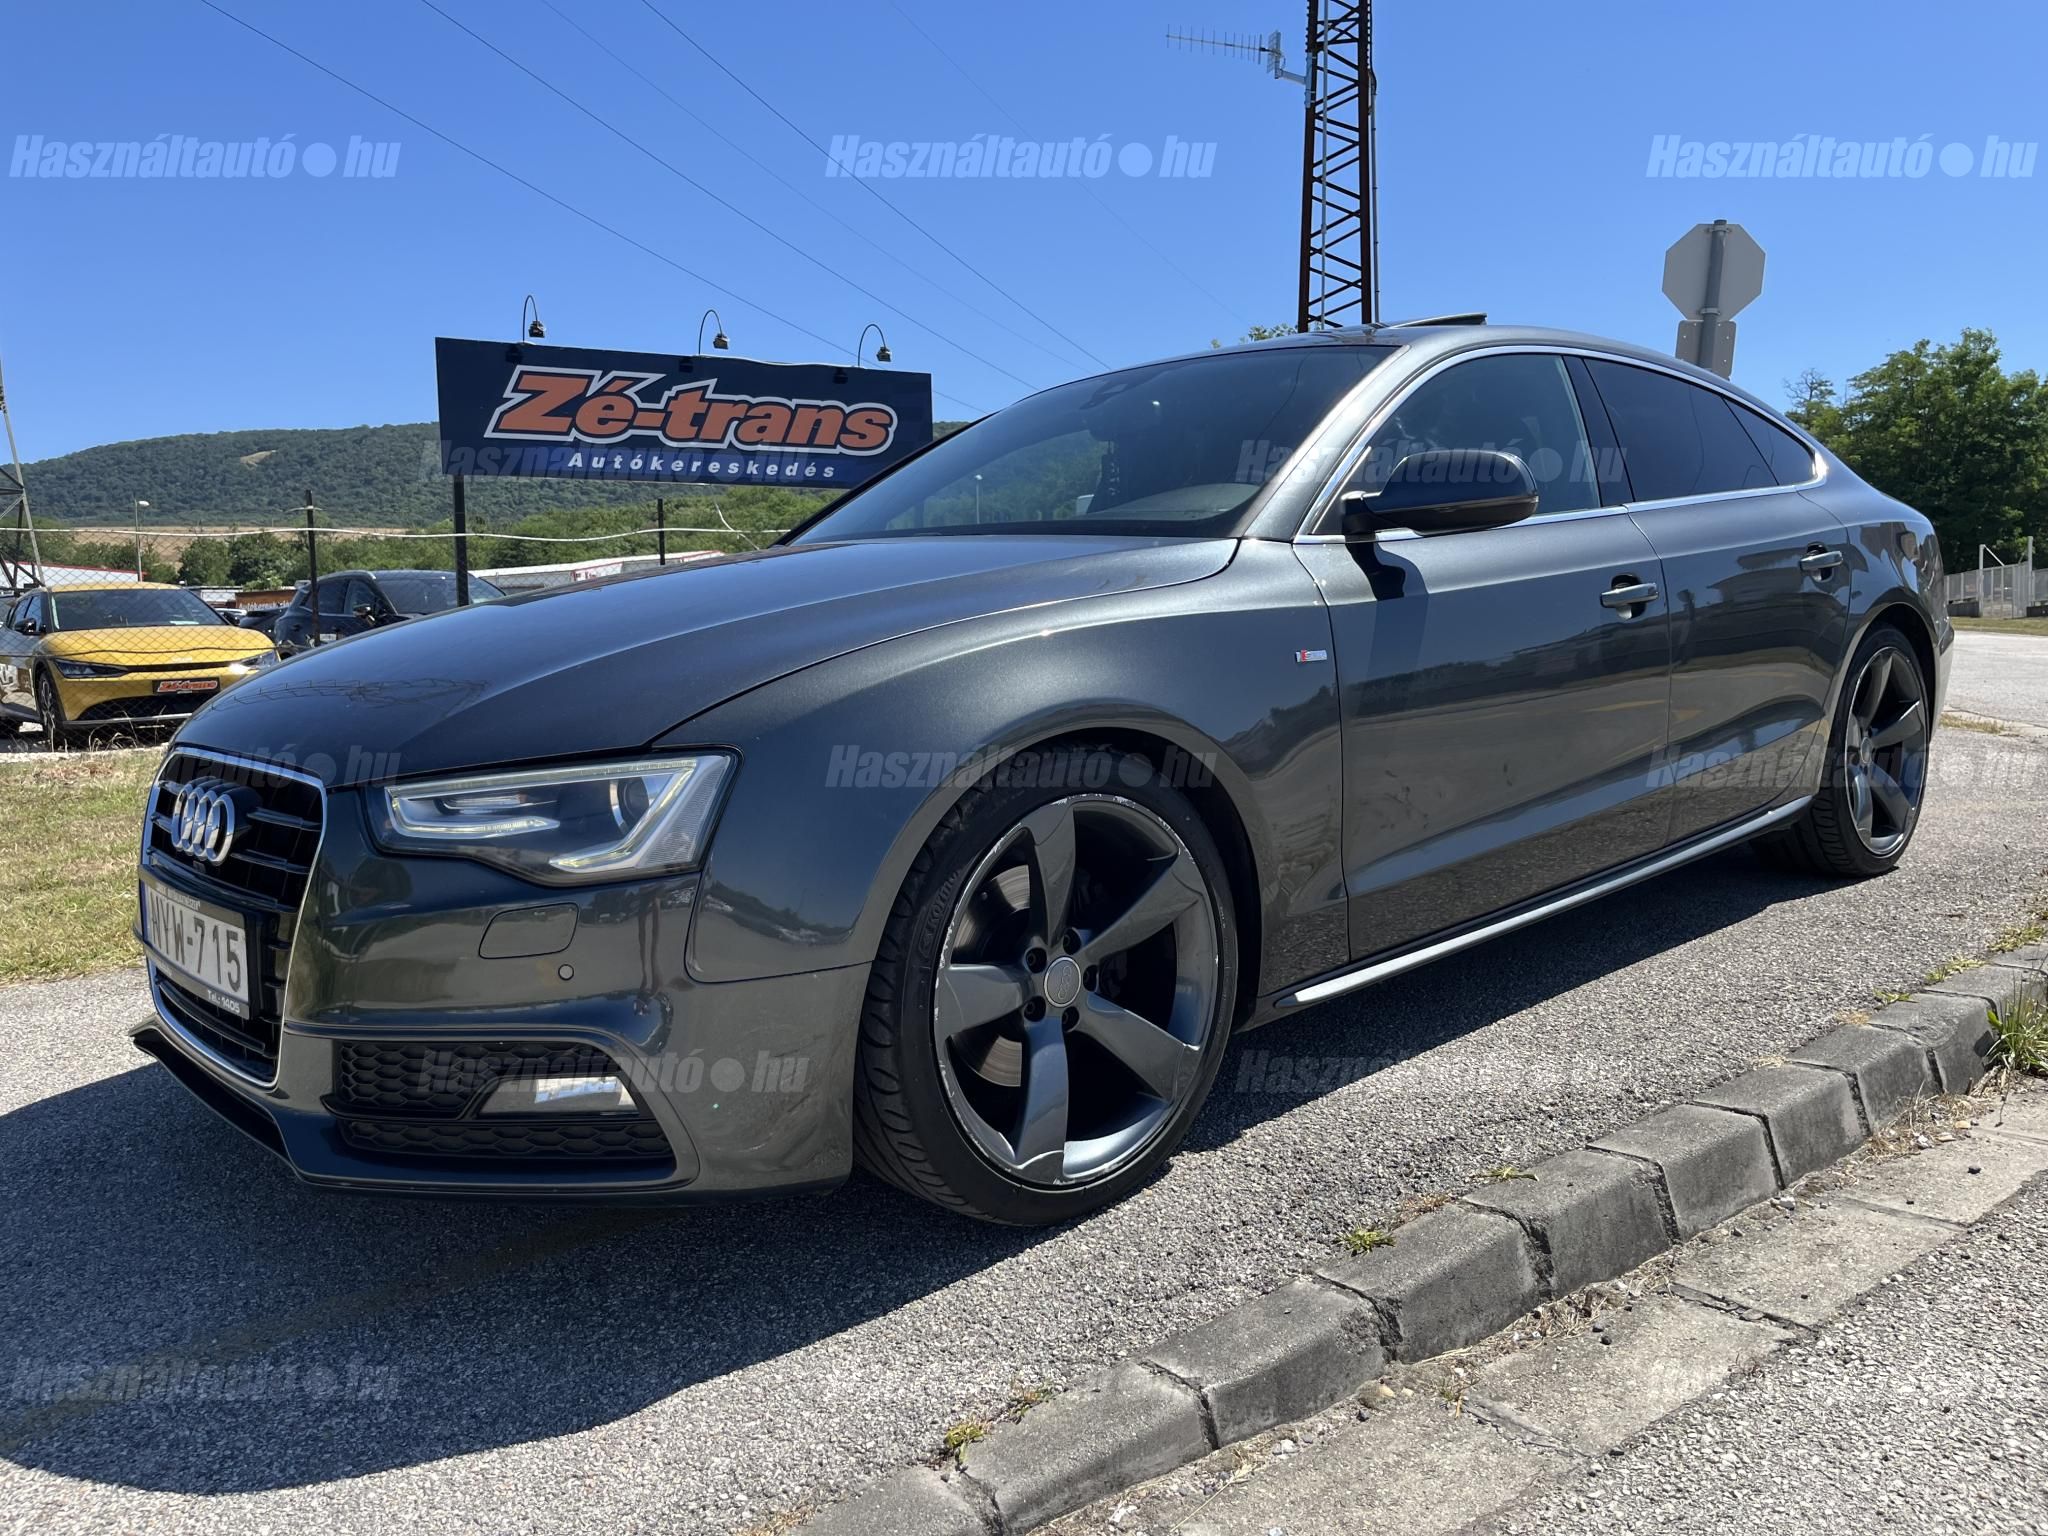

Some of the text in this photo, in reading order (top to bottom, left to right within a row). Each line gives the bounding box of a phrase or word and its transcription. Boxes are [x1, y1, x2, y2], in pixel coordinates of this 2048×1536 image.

[486, 366, 896, 454] Zé-trans
[568, 451, 835, 478] Autókereskedés
[149, 890, 242, 993] NYW-715
